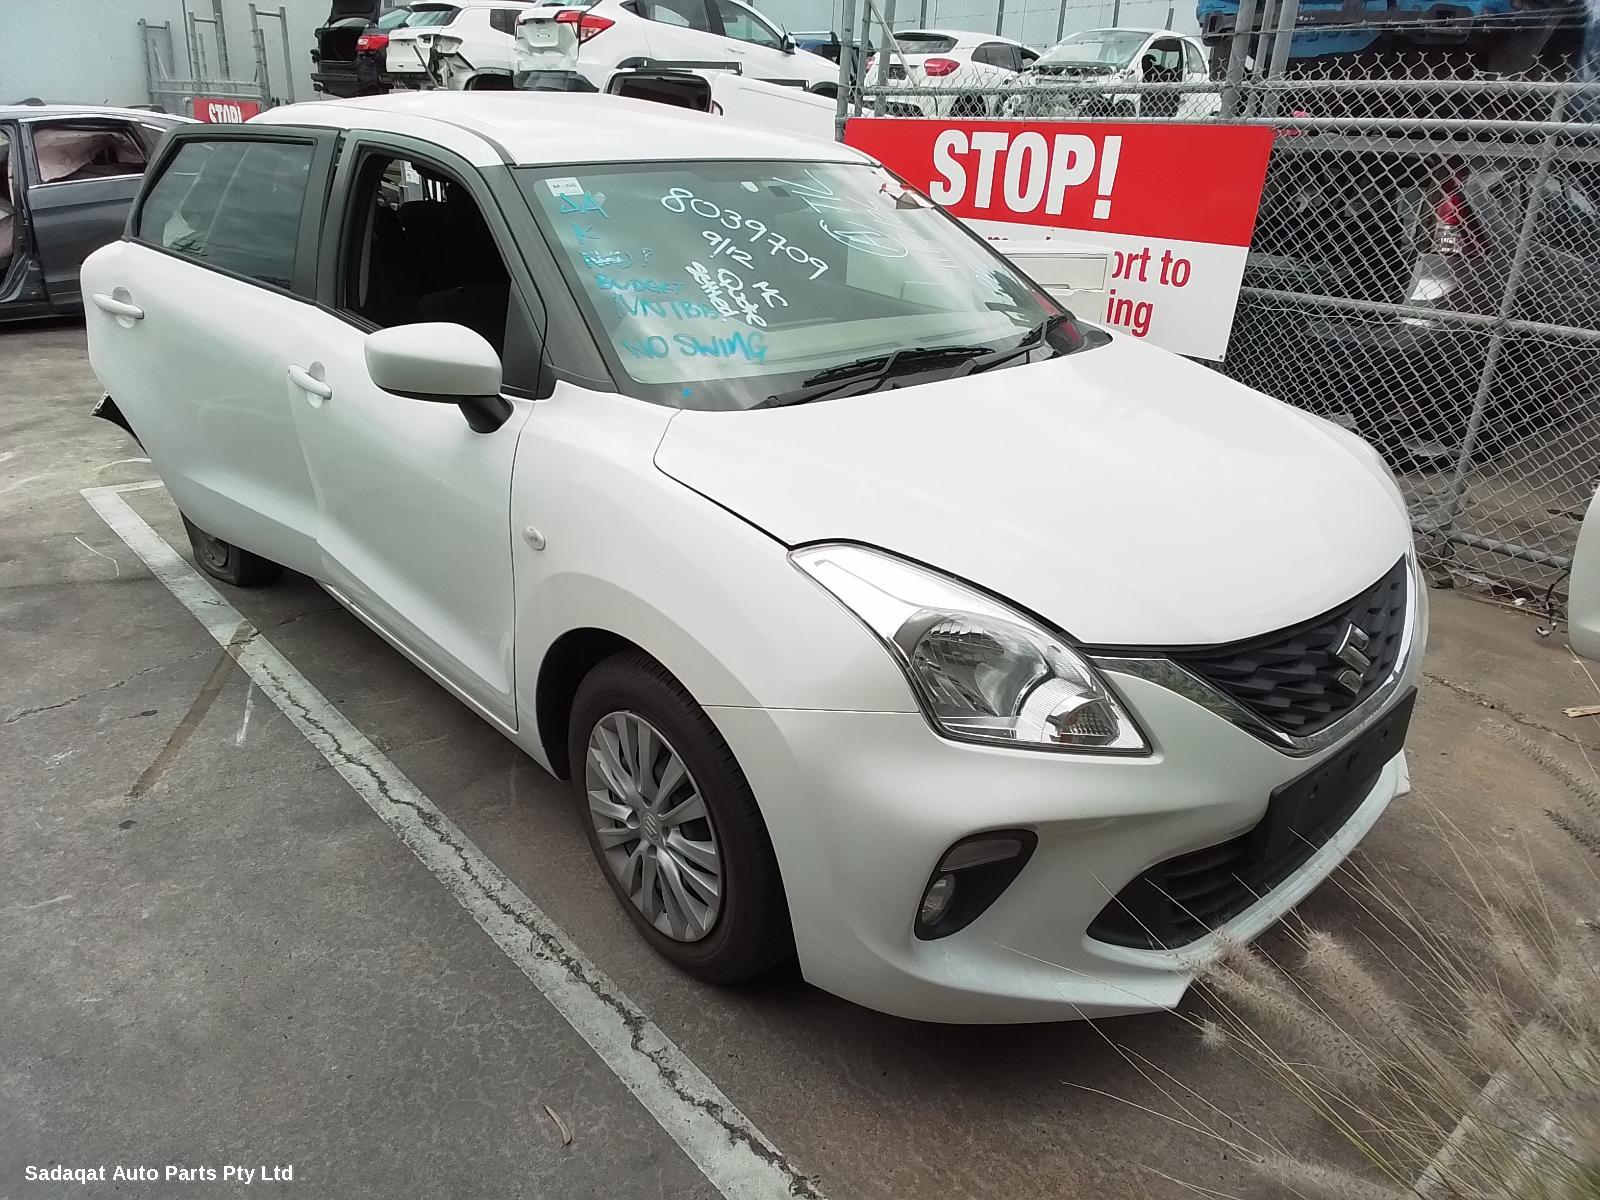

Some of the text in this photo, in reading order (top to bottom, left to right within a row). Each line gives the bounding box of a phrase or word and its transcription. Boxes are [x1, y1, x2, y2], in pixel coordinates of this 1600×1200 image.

[929, 128, 1123, 221] STOP!
[661, 187, 829, 280] 8039709
[702, 230, 755, 269] 9/12
[1160, 249, 1191, 287] to
[1106, 289, 1153, 337] ing
